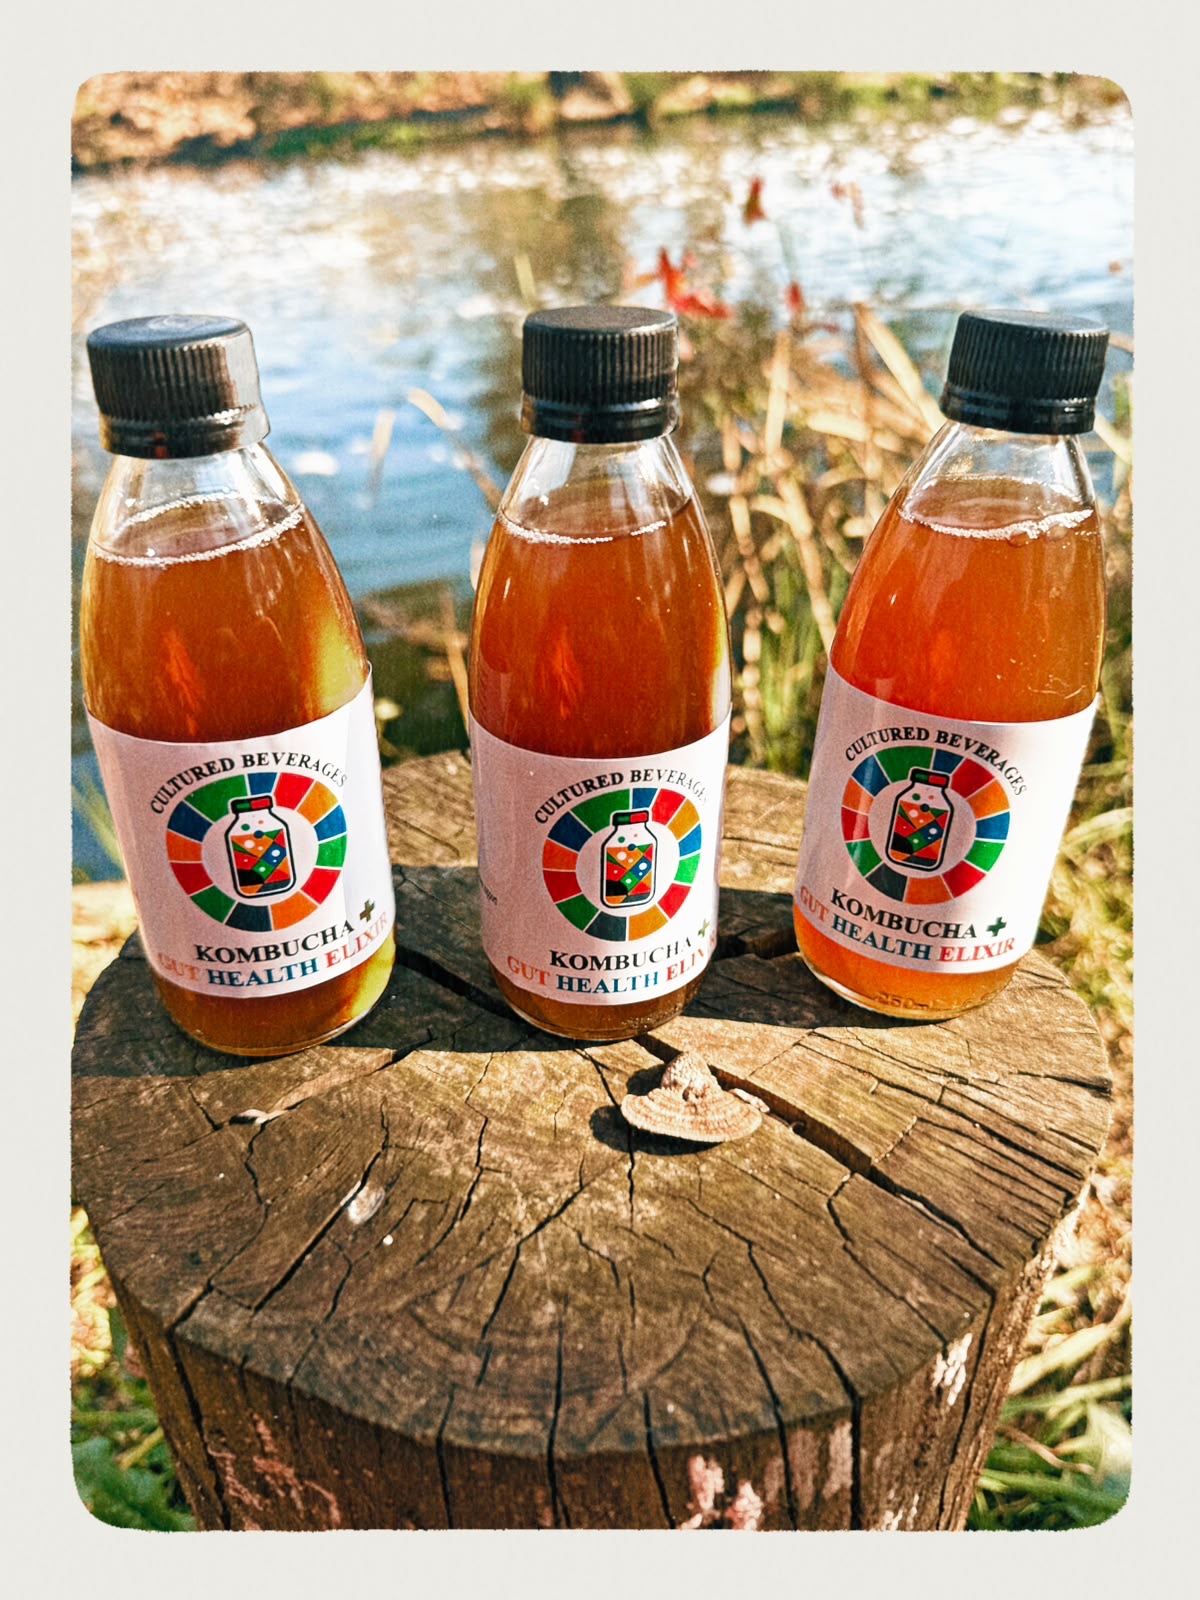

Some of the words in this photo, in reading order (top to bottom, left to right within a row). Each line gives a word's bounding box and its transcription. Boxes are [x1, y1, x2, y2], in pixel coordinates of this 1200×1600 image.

[150, 758, 235, 815] CULTURED
[242, 752, 348, 788] BEVERAGES
[844, 726, 930, 762] CULTURED
[935, 730, 1028, 796] BEVERAGES
[534, 772, 624, 824] CULTURED
[630, 768, 707, 804] BEVERAGE
[194, 919, 355, 963] KOMBUCHA
[800, 885, 829, 922] GUT
[831, 912, 934, 961] HEALTH
[937, 936, 1015, 962] ELIXIR
[831, 887, 977, 939] KOMBUCHA
[158, 953, 199, 981] GUT
[206, 956, 319, 987] HEALTH
[325, 911, 389, 968] ELIXIR
[507, 955, 550, 986] GUT
[556, 970, 658, 994] HEALTH
[549, 936, 692, 971] KOMBUCHA
